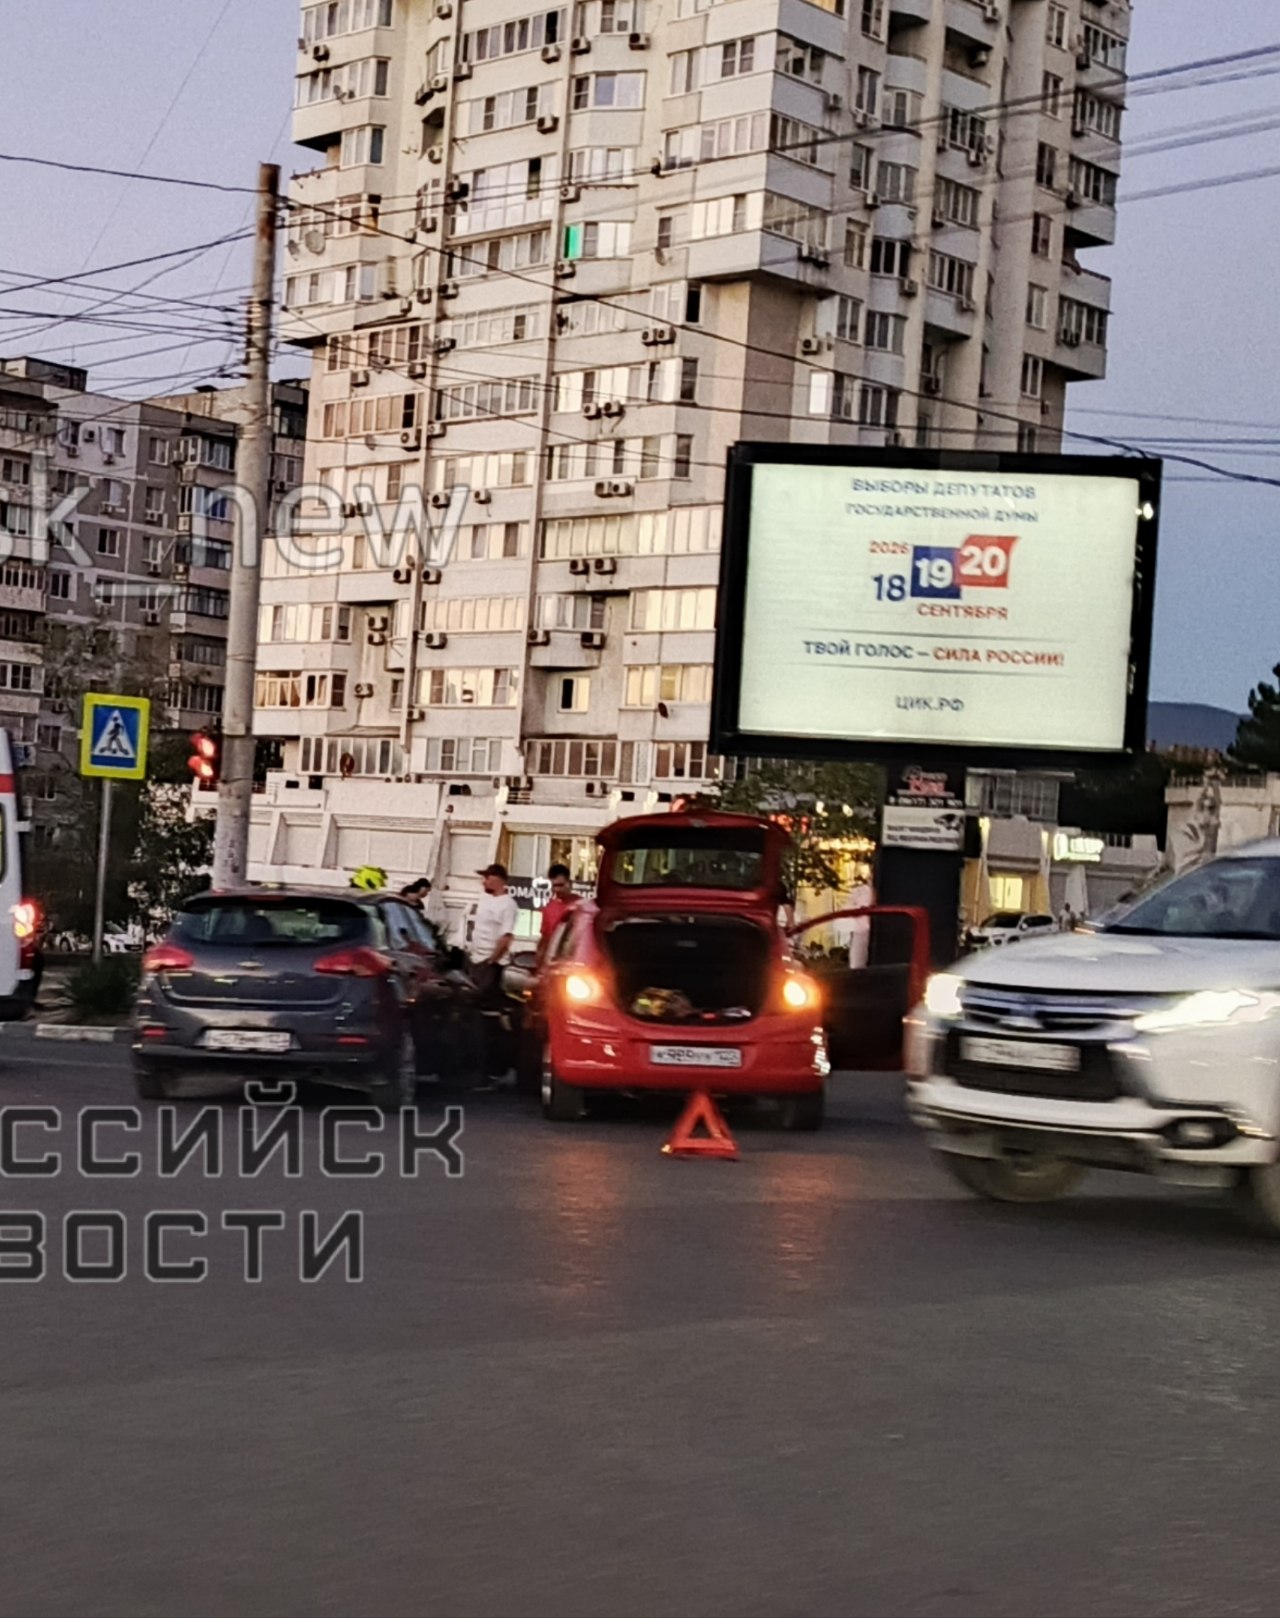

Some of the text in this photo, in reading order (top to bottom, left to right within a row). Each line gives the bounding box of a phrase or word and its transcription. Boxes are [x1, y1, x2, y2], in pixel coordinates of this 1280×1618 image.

[852, 478, 1036, 500] ВЫБОРЫ ДЕПУТАТОВ
[847, 503, 1039, 523] ГОСУДАРСТВЕННОЙ ДУМЫ
[872, 546, 1007, 602] 18 19 20
[916, 603, 1009, 620] СЕНТЯБРЯ
[802, 639, 851, 657] ТВОЙ
[855, 643, 914, 660] ГОЛОС
[932, 646, 982, 662] СИЛА
[896, 695, 965, 712] ЦИК.РФ
